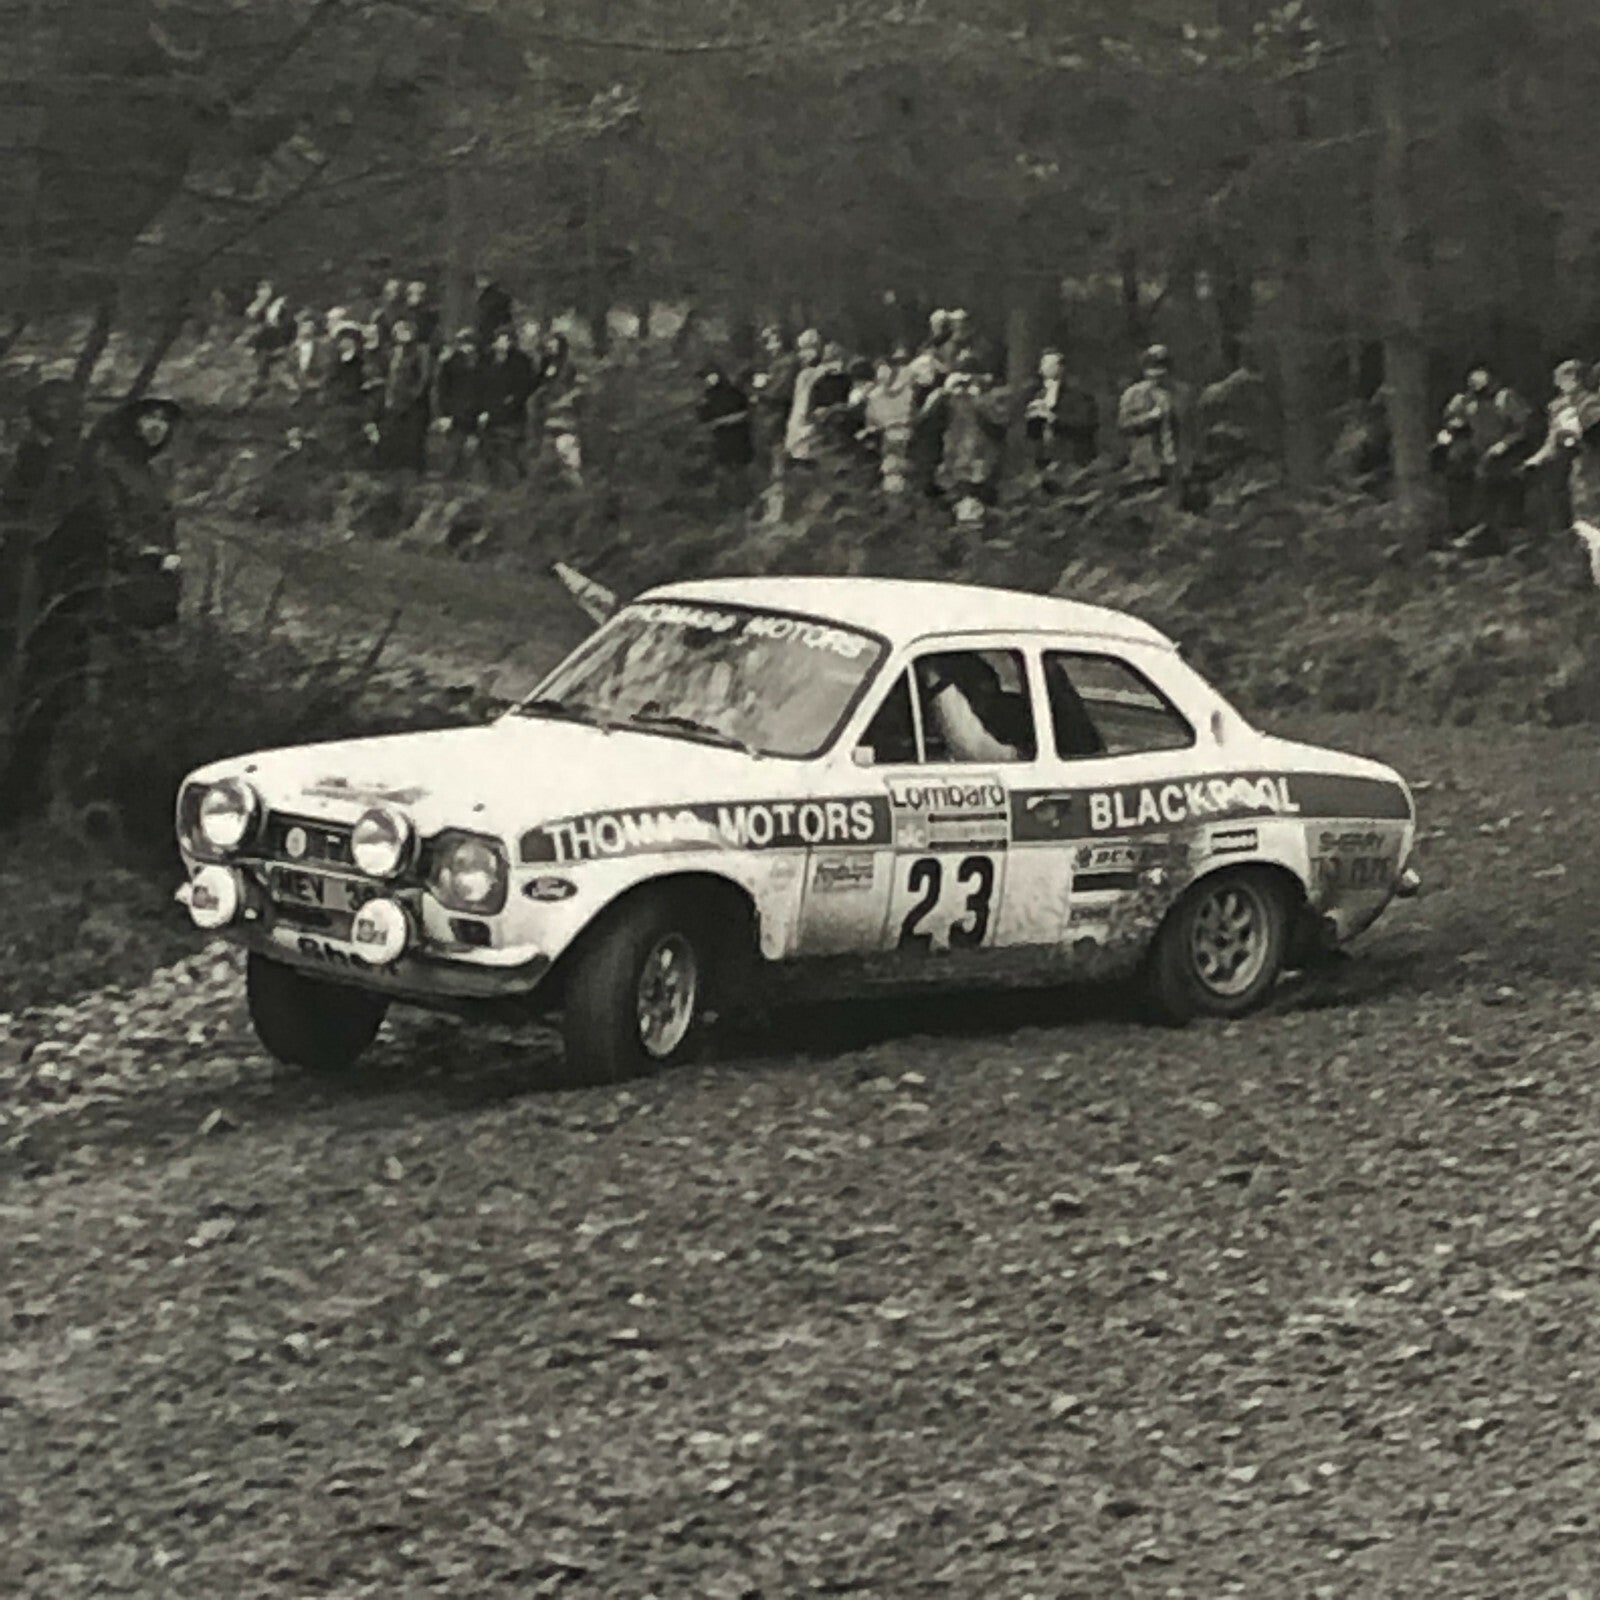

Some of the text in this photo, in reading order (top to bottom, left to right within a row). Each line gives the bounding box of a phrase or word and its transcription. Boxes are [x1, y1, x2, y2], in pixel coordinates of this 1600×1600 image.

[717, 801, 874, 846] MOTORS
[1089, 777, 1300, 830] BLACKPOOL
[898, 856, 994, 949] 23
